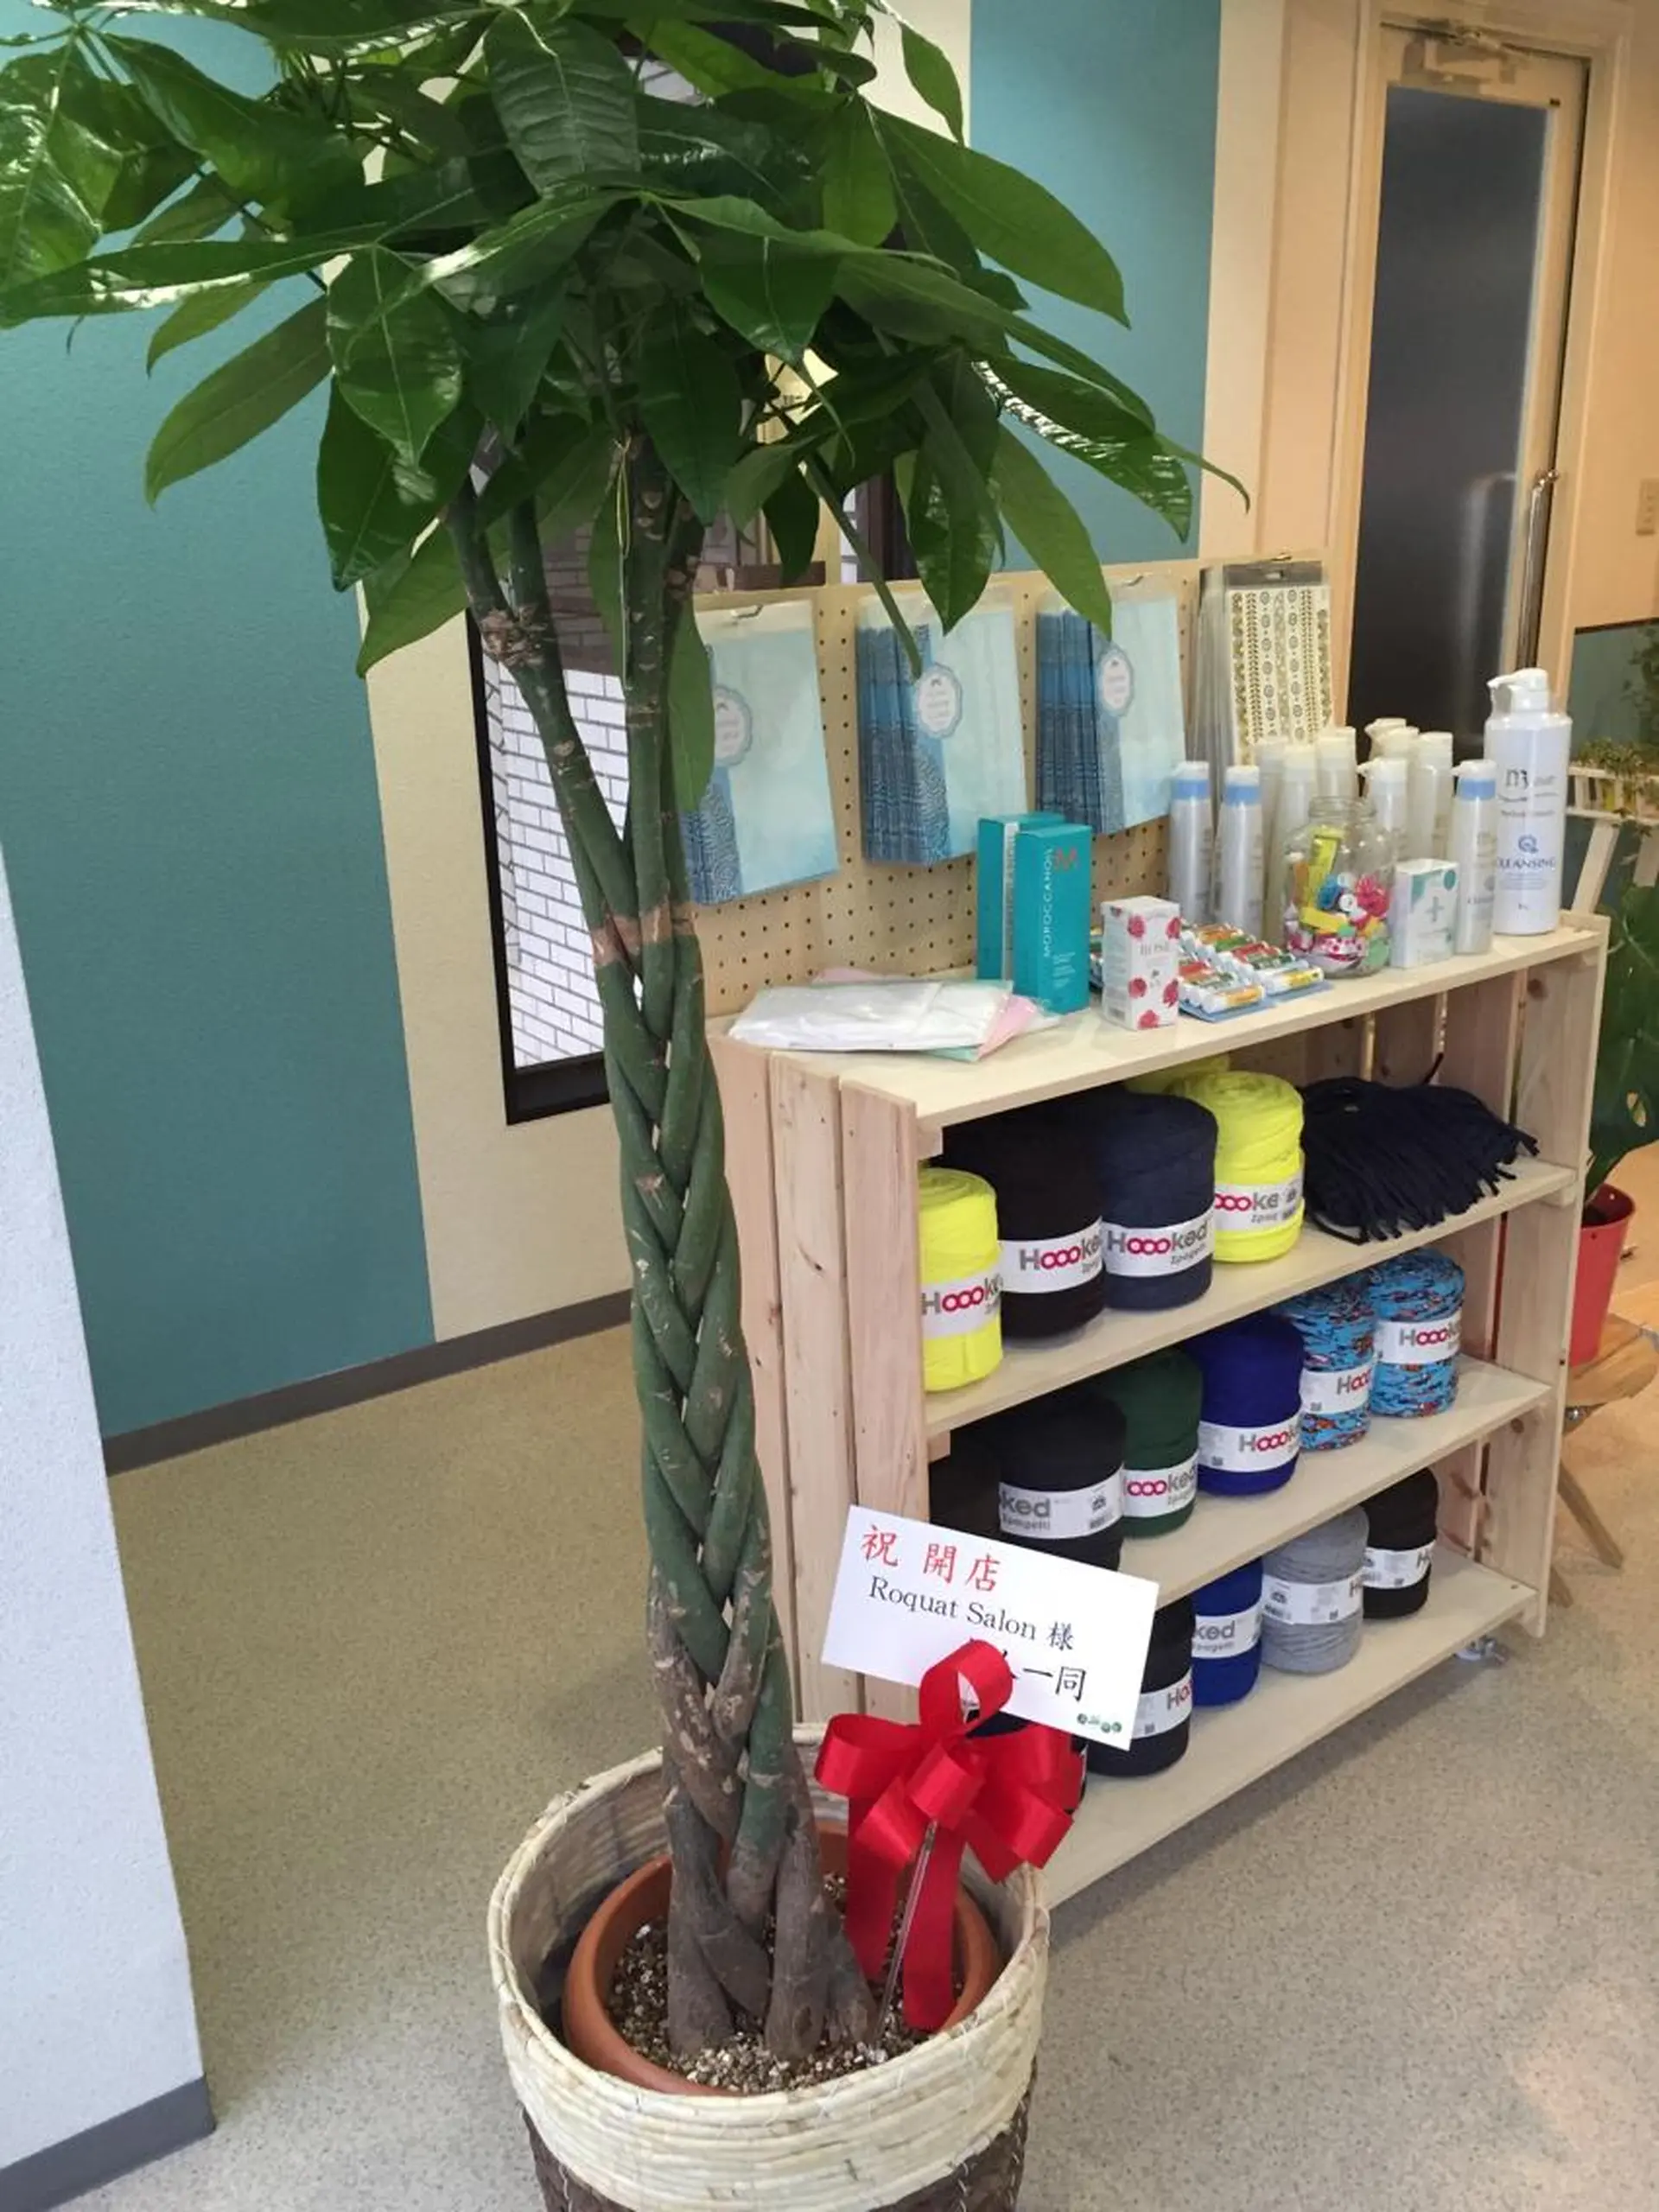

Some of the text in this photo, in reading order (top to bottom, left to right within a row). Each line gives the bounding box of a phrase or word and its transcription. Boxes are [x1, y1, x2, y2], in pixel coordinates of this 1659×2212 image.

[1107, 1219, 1208, 1255] Hoooked
[861, 1525, 1001, 1592] 祝 開店
[868, 1576, 959, 1620] Roquat
[966, 1601, 1037, 1642] Salon
